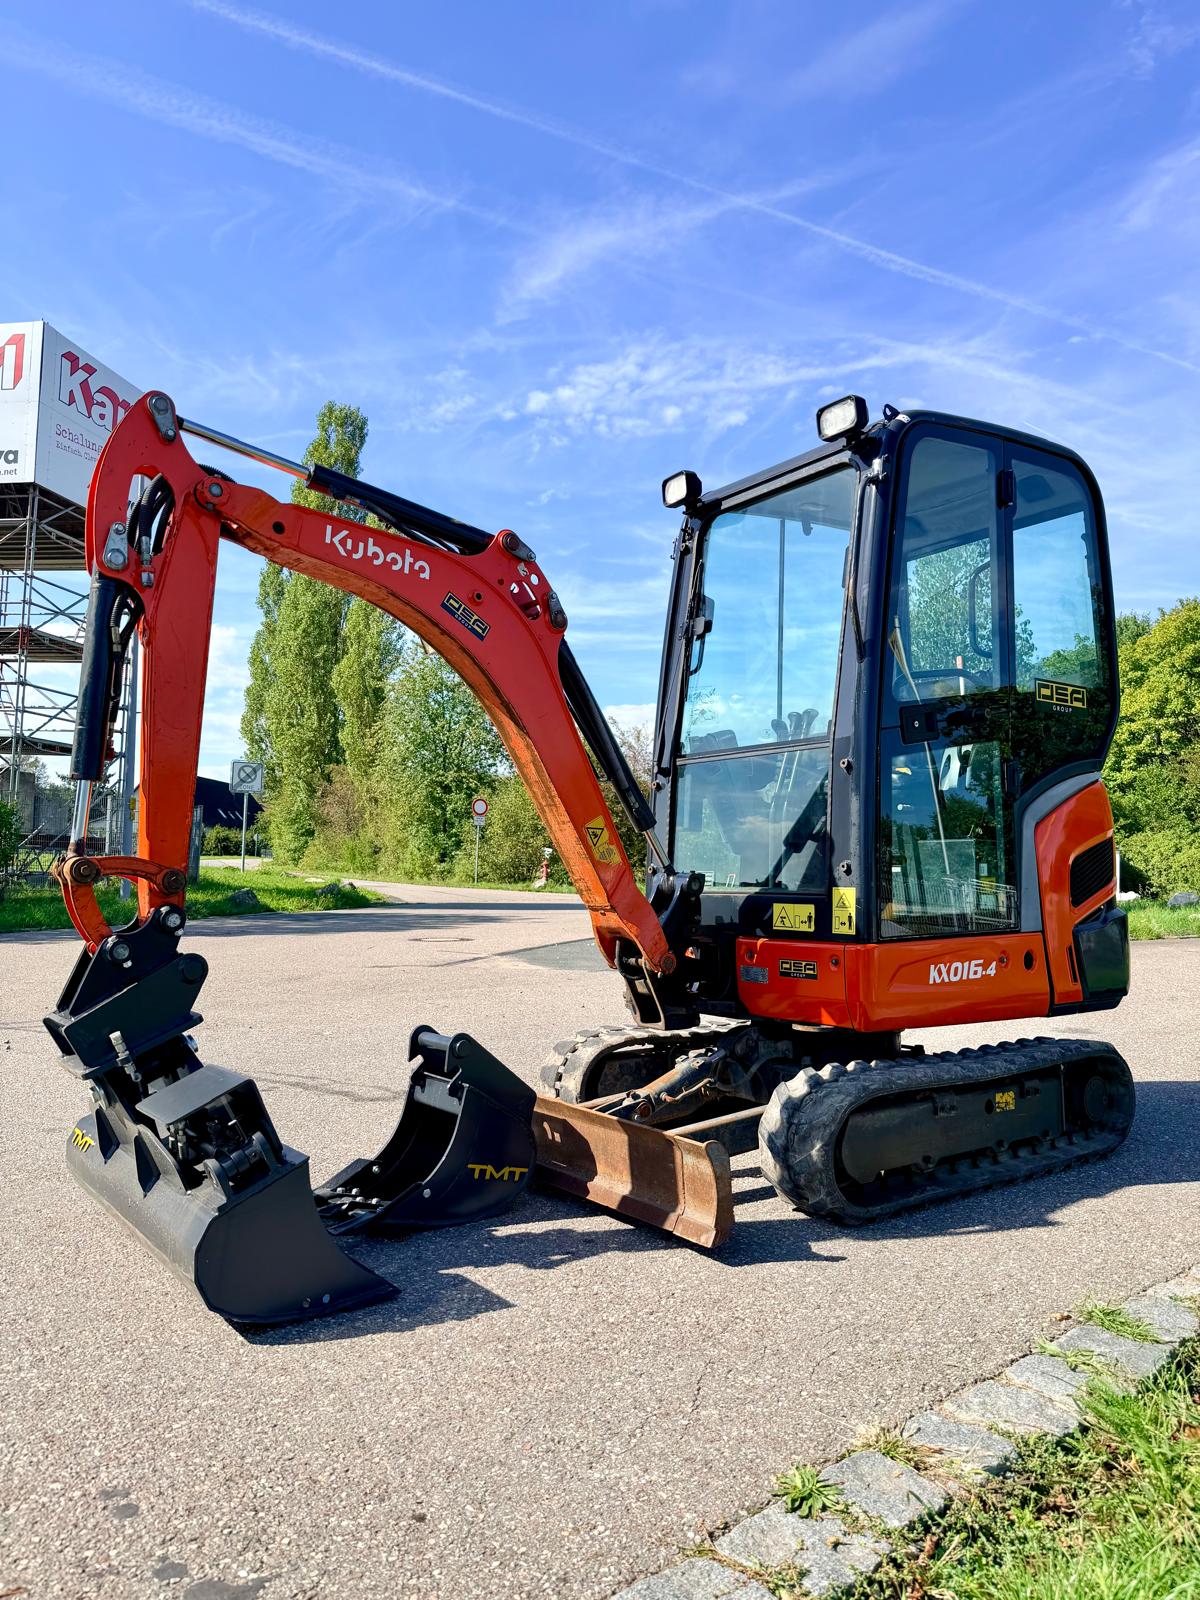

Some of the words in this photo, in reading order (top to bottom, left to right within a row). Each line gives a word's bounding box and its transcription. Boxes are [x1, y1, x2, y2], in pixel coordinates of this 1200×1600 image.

[325, 525, 431, 580] Kubota
[1052, 704, 1073, 713] GROUP
[72, 1127, 95, 1153] TMT
[466, 1164, 529, 1181] TMT
